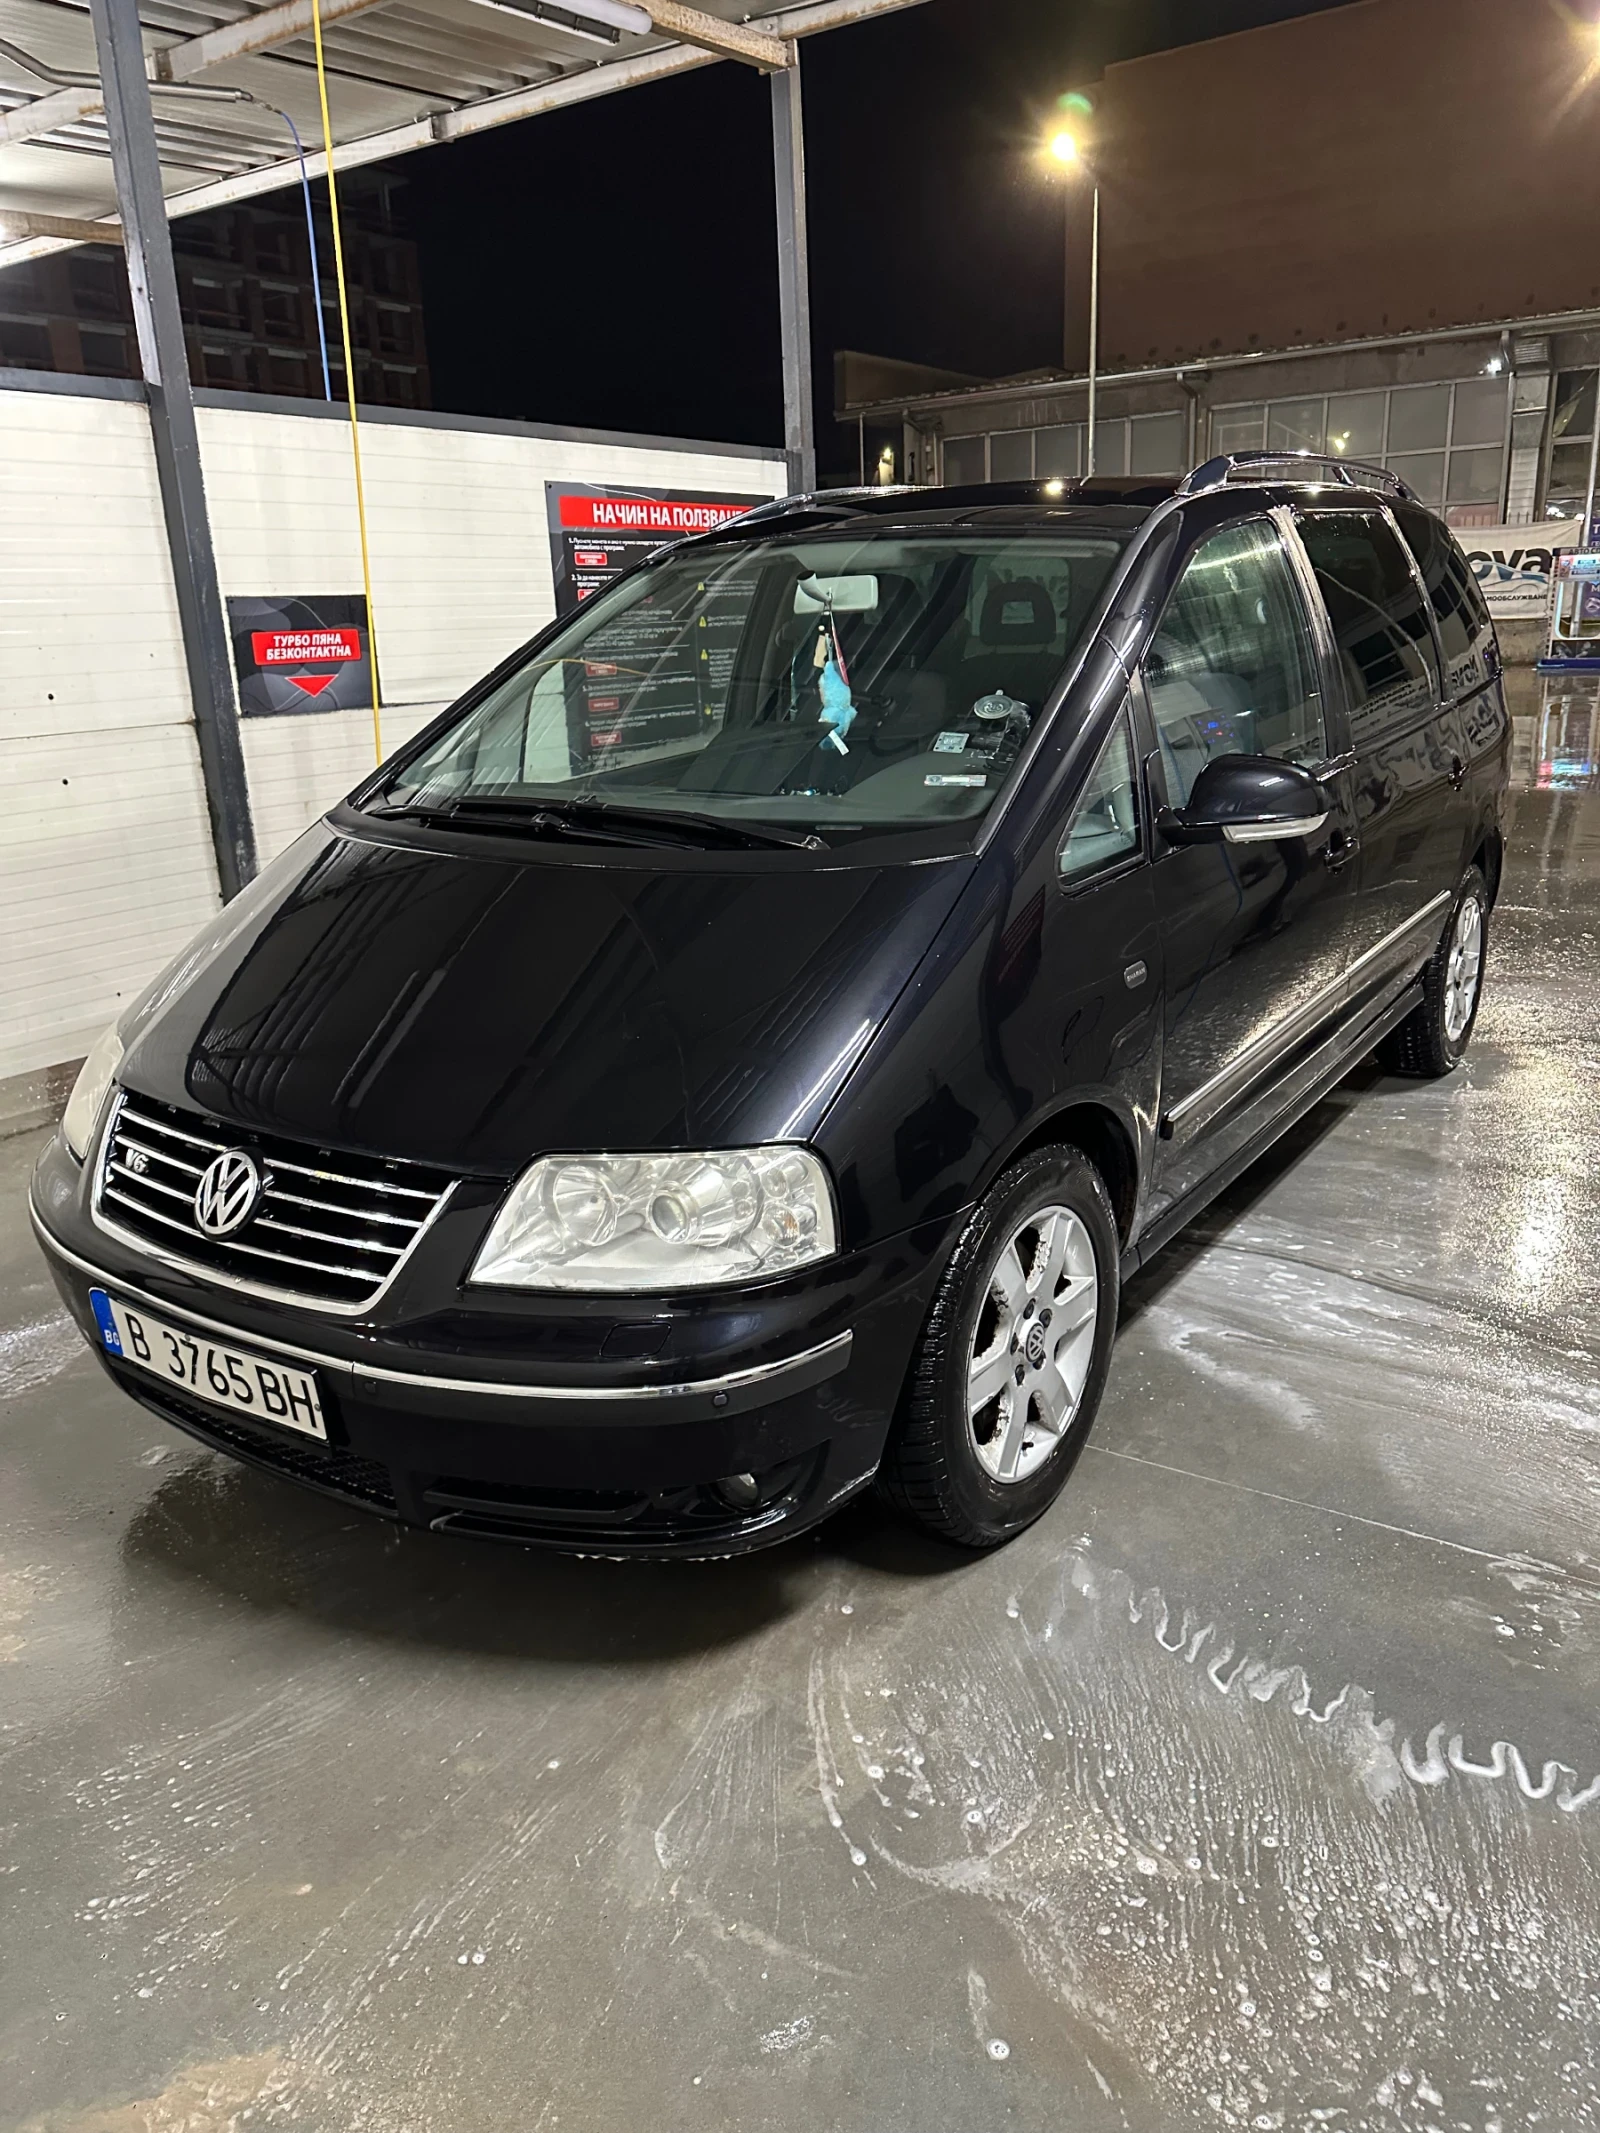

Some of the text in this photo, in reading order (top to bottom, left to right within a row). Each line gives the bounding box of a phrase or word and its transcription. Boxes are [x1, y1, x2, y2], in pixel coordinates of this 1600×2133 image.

[593, 502, 744, 529] НАЧИН НА ПОЛЗВА
[1466, 548, 1553, 582] ova
[1485, 594, 1547, 602] МООБСЛУЖВАНЕ
[273, 633, 341, 647] ТУРБО ПЯНА
[266, 646, 351, 661] БЕЗКОНТАКТНА
[104, 1329, 120, 1346] BG
[162, 1331, 254, 1404] 3765
